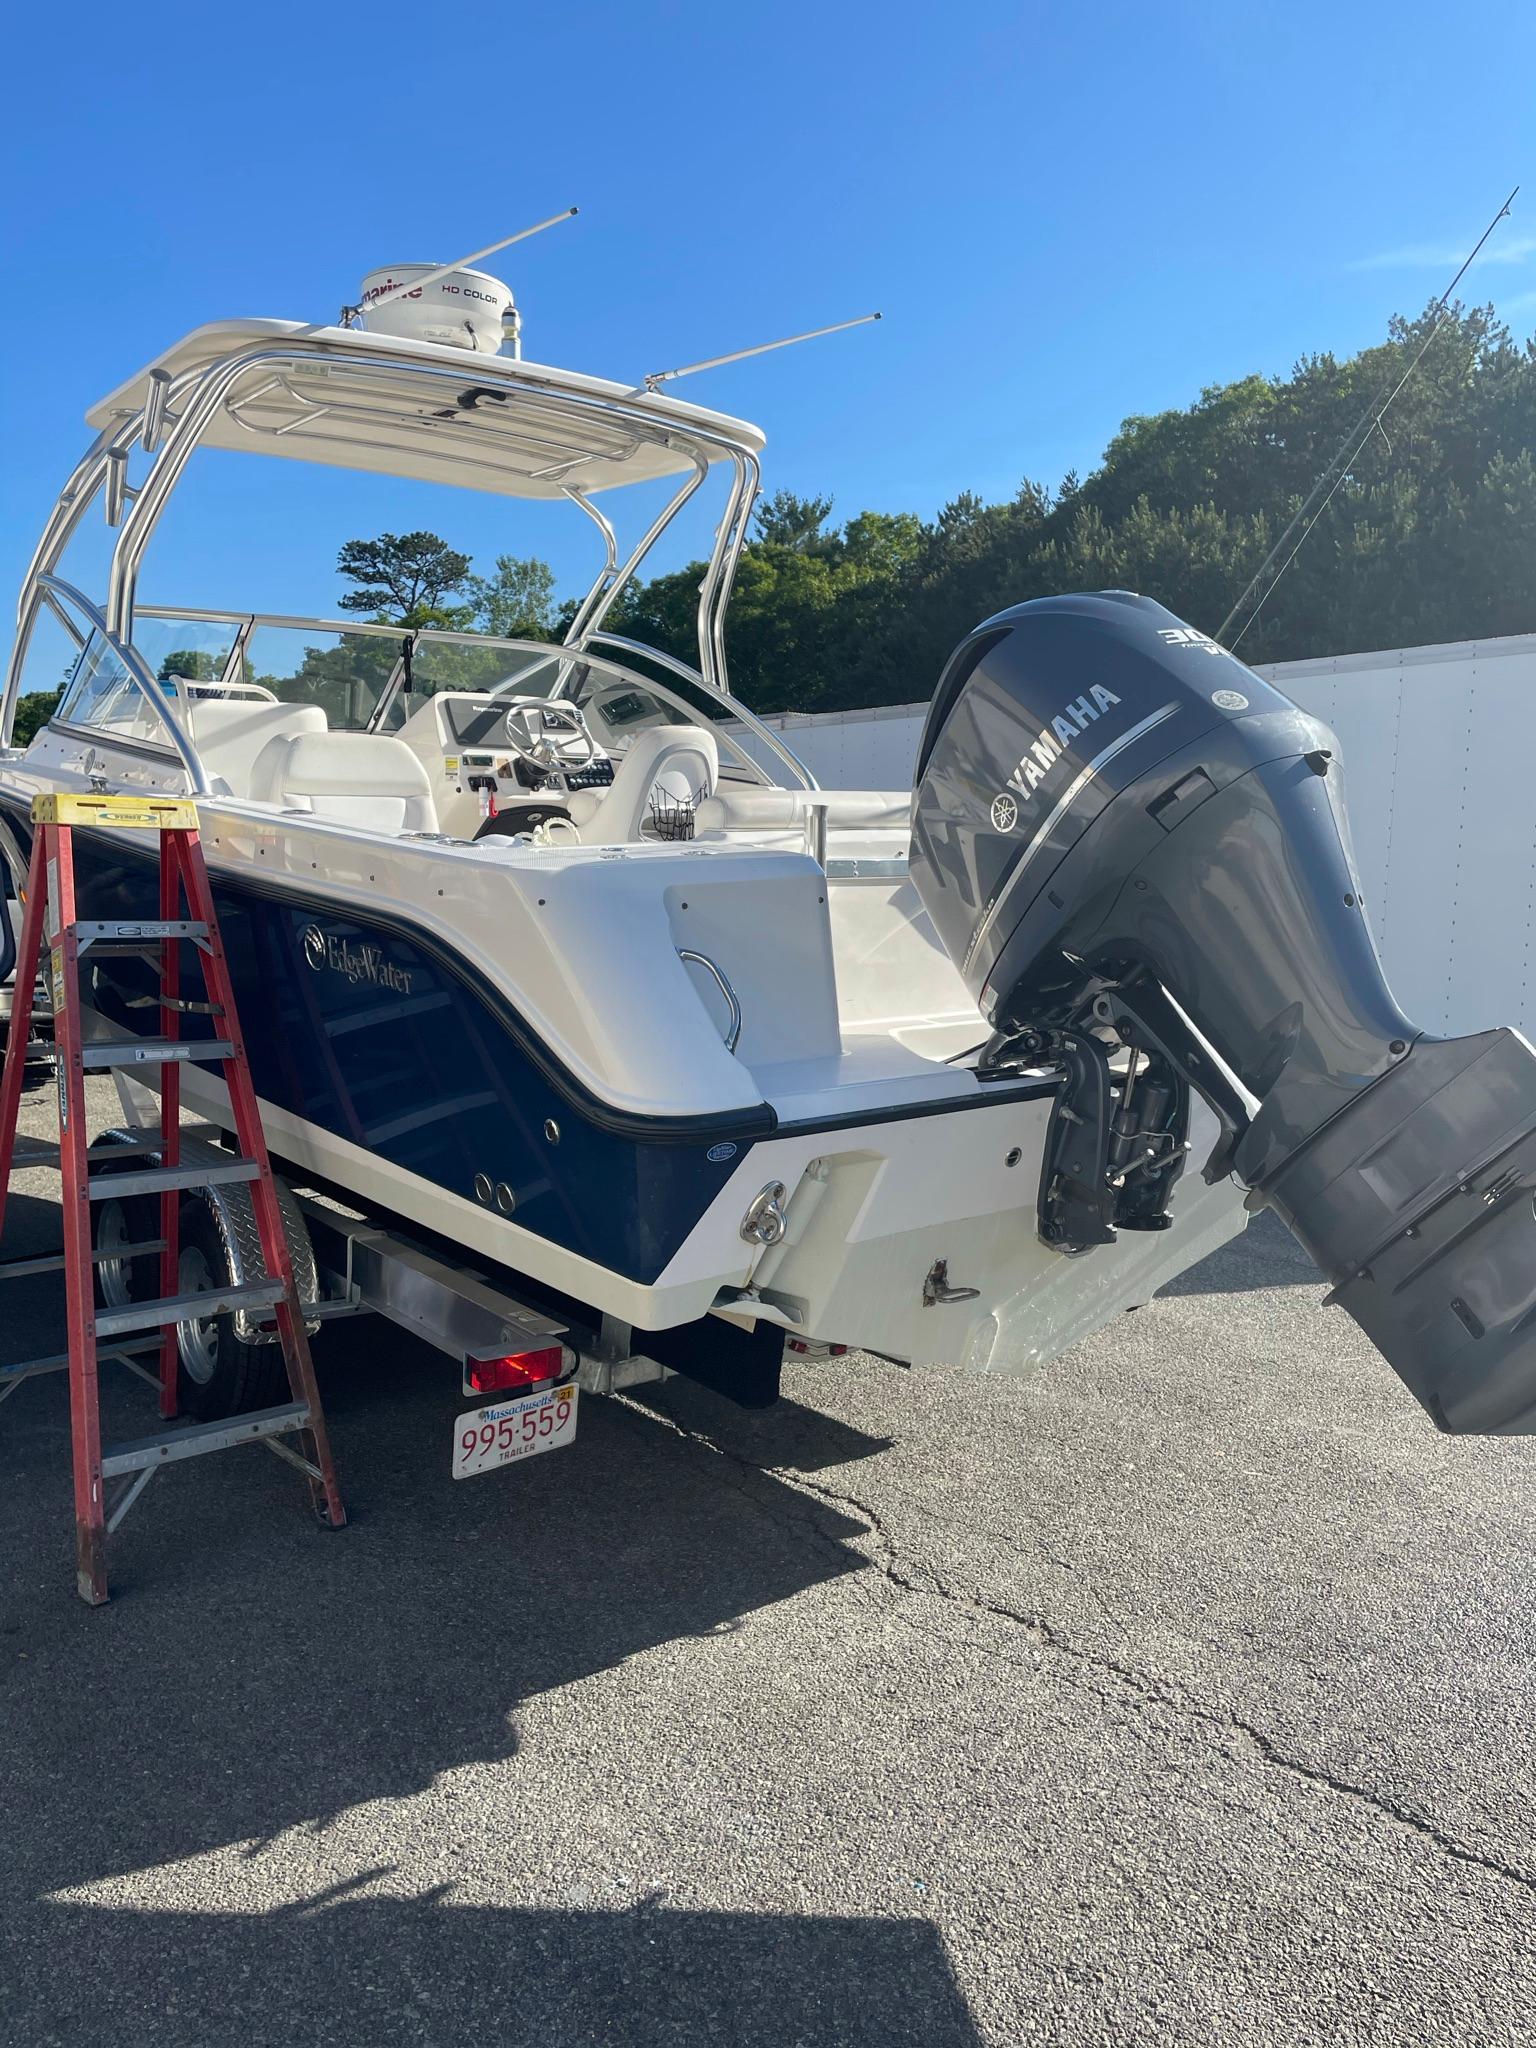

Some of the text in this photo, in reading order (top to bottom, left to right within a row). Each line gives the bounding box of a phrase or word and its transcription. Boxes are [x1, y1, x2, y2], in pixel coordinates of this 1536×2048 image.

[442, 285, 498, 304] HD COLOR
[1006, 684, 1122, 800] YAMAHA
[327, 935, 412, 995] EdgeWater
[560, 1391, 571, 1401] 21
[484, 1395, 553, 1423] Massachusetts
[499, 1442, 536, 1461] TRAILER
